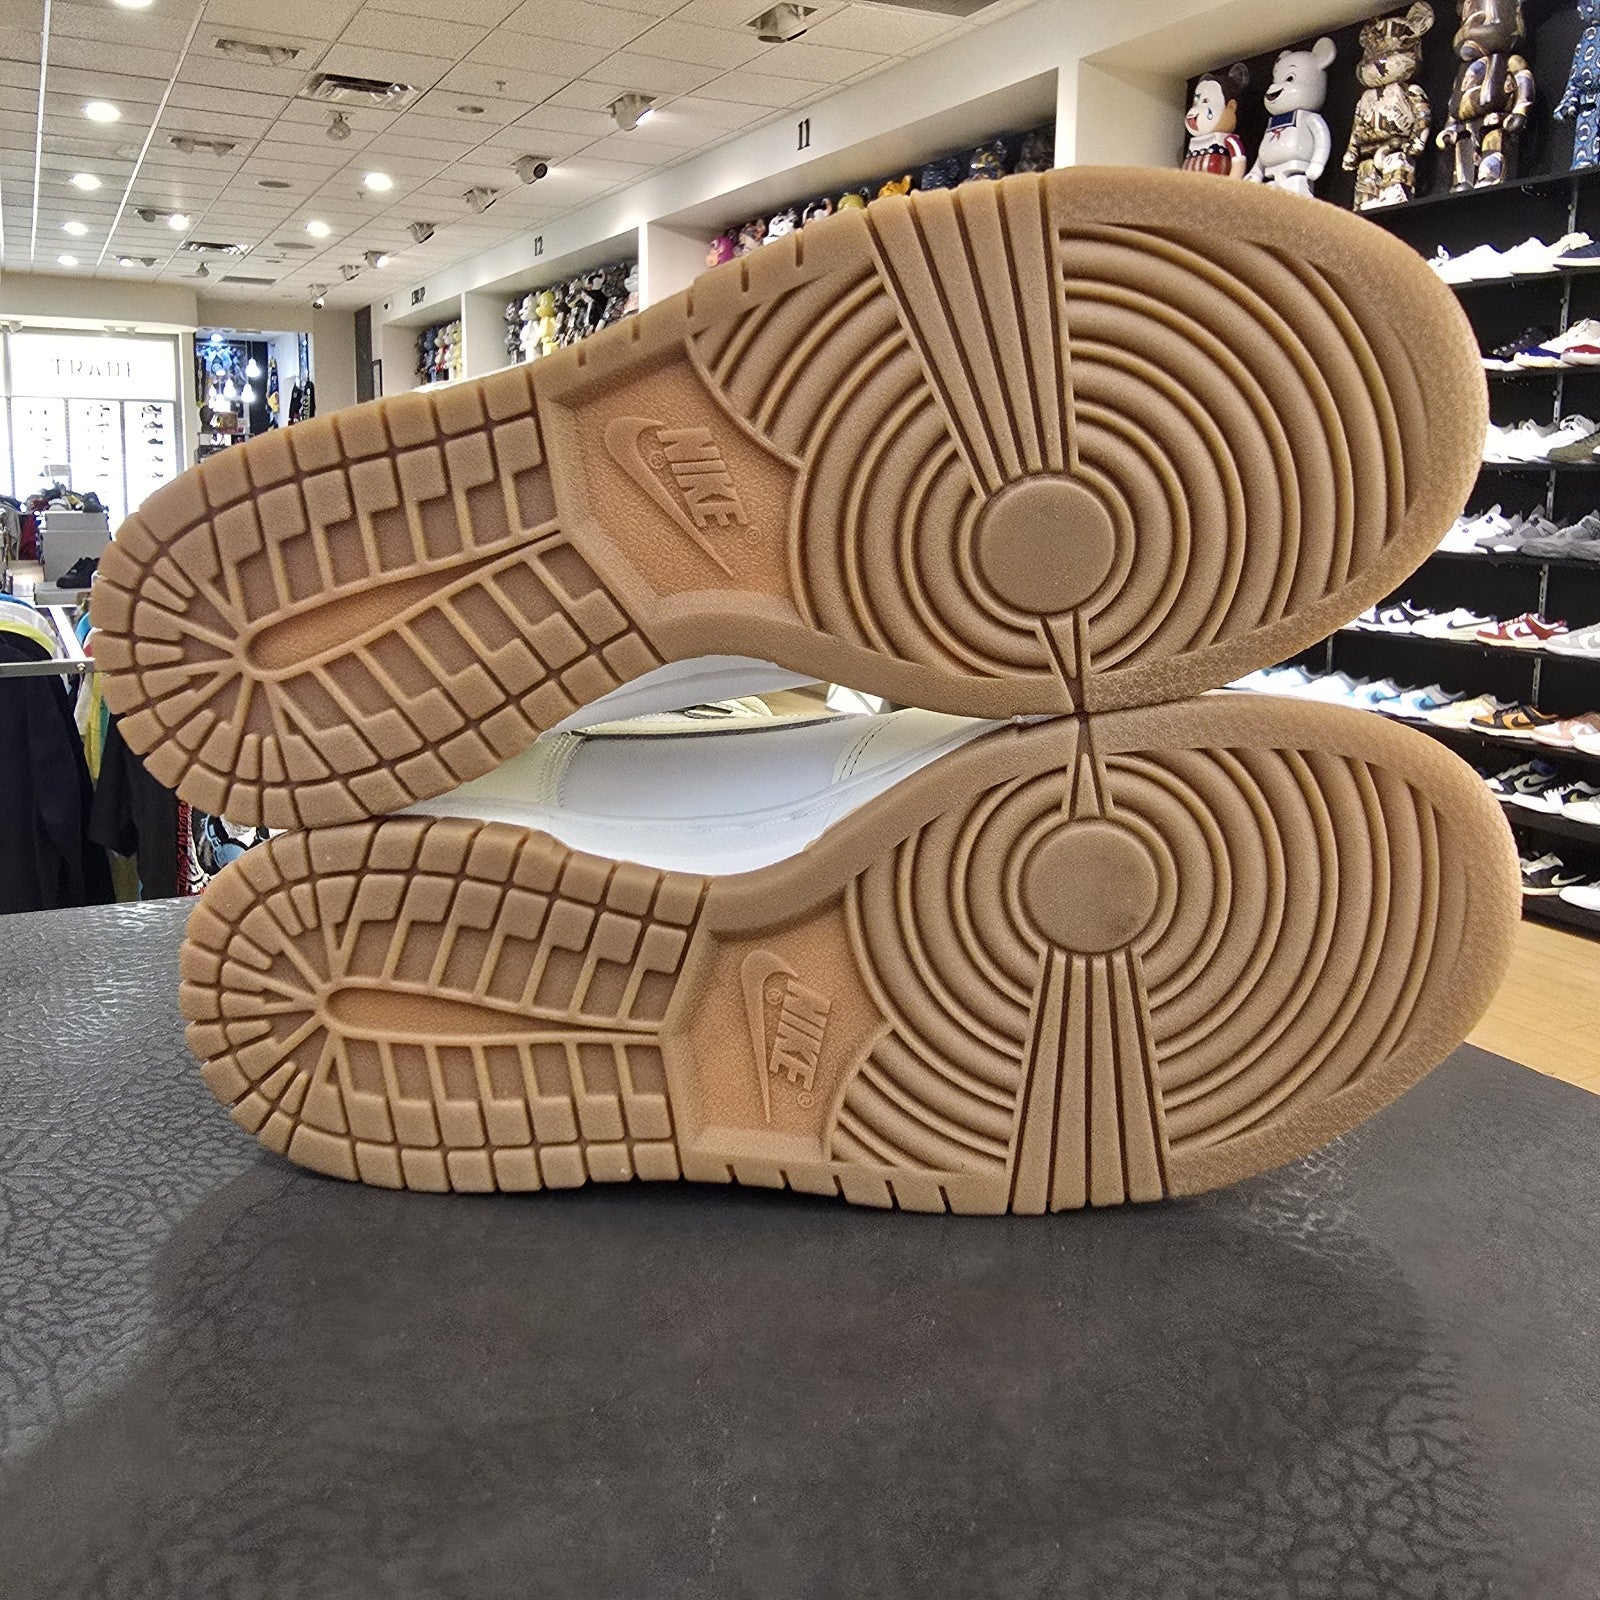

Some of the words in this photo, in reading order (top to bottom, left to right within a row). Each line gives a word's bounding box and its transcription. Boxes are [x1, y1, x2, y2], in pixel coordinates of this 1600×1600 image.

[797, 118, 811, 151] 11
[534, 235, 544, 257] 12
[656, 427, 749, 528] NIKE
[769, 978, 833, 1093] NIKE
